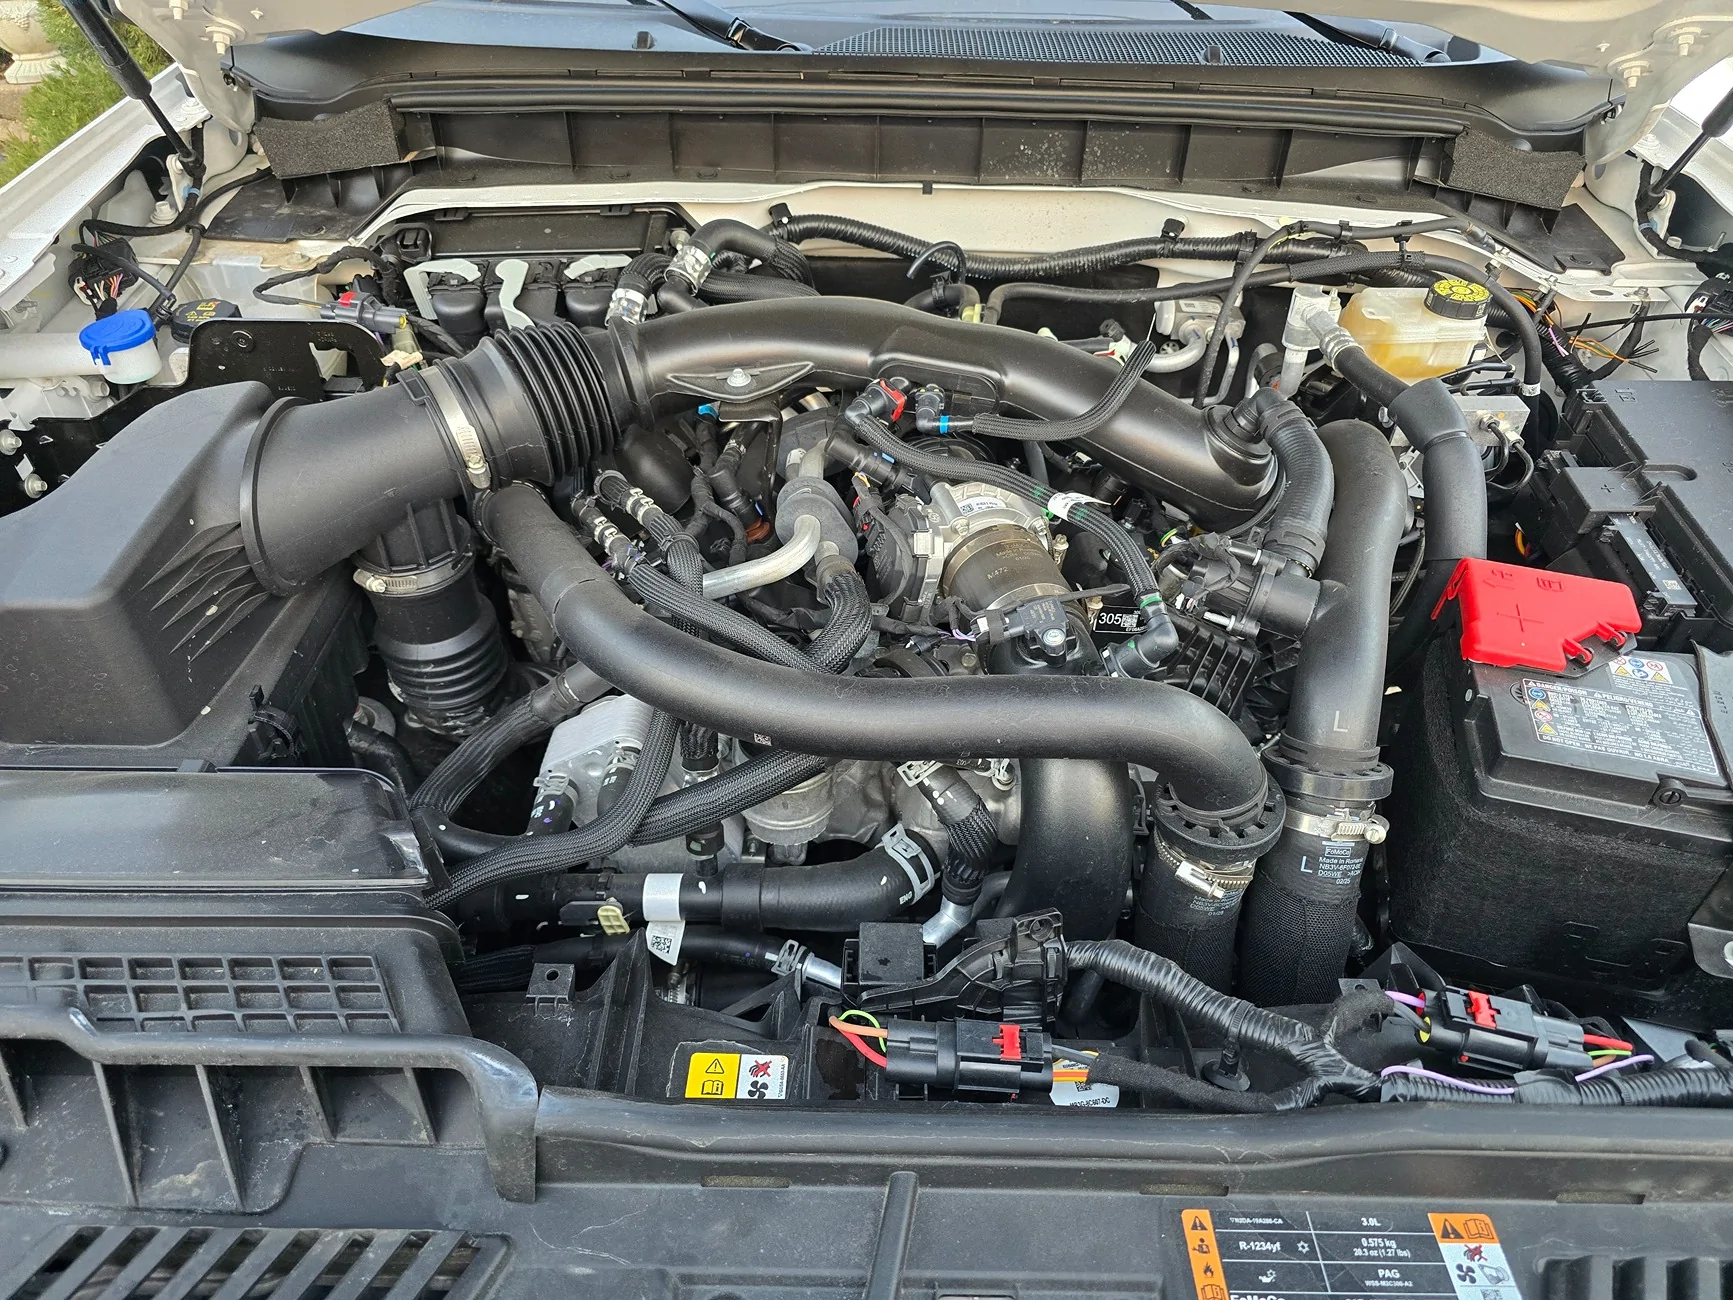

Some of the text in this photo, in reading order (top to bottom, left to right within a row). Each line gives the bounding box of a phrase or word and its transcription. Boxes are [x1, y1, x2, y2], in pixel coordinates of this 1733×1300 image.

[1098, 612, 1122, 625] 305
[1333, 710, 1349, 733] L
[1326, 848, 1350, 856] FoMoCo
[1300, 855, 1313, 874] L
[1361, 1217, 1381, 1226] 3.0L
[1239, 1241, 1281, 1253] R-1234yf
[1361, 1238, 1397, 1249] 0.575 kg
[1353, 1248, 1369, 1256] 20.3
[1379, 1248, 1395, 1258] (1.27
[1377, 1269, 1401, 1278] PAG
